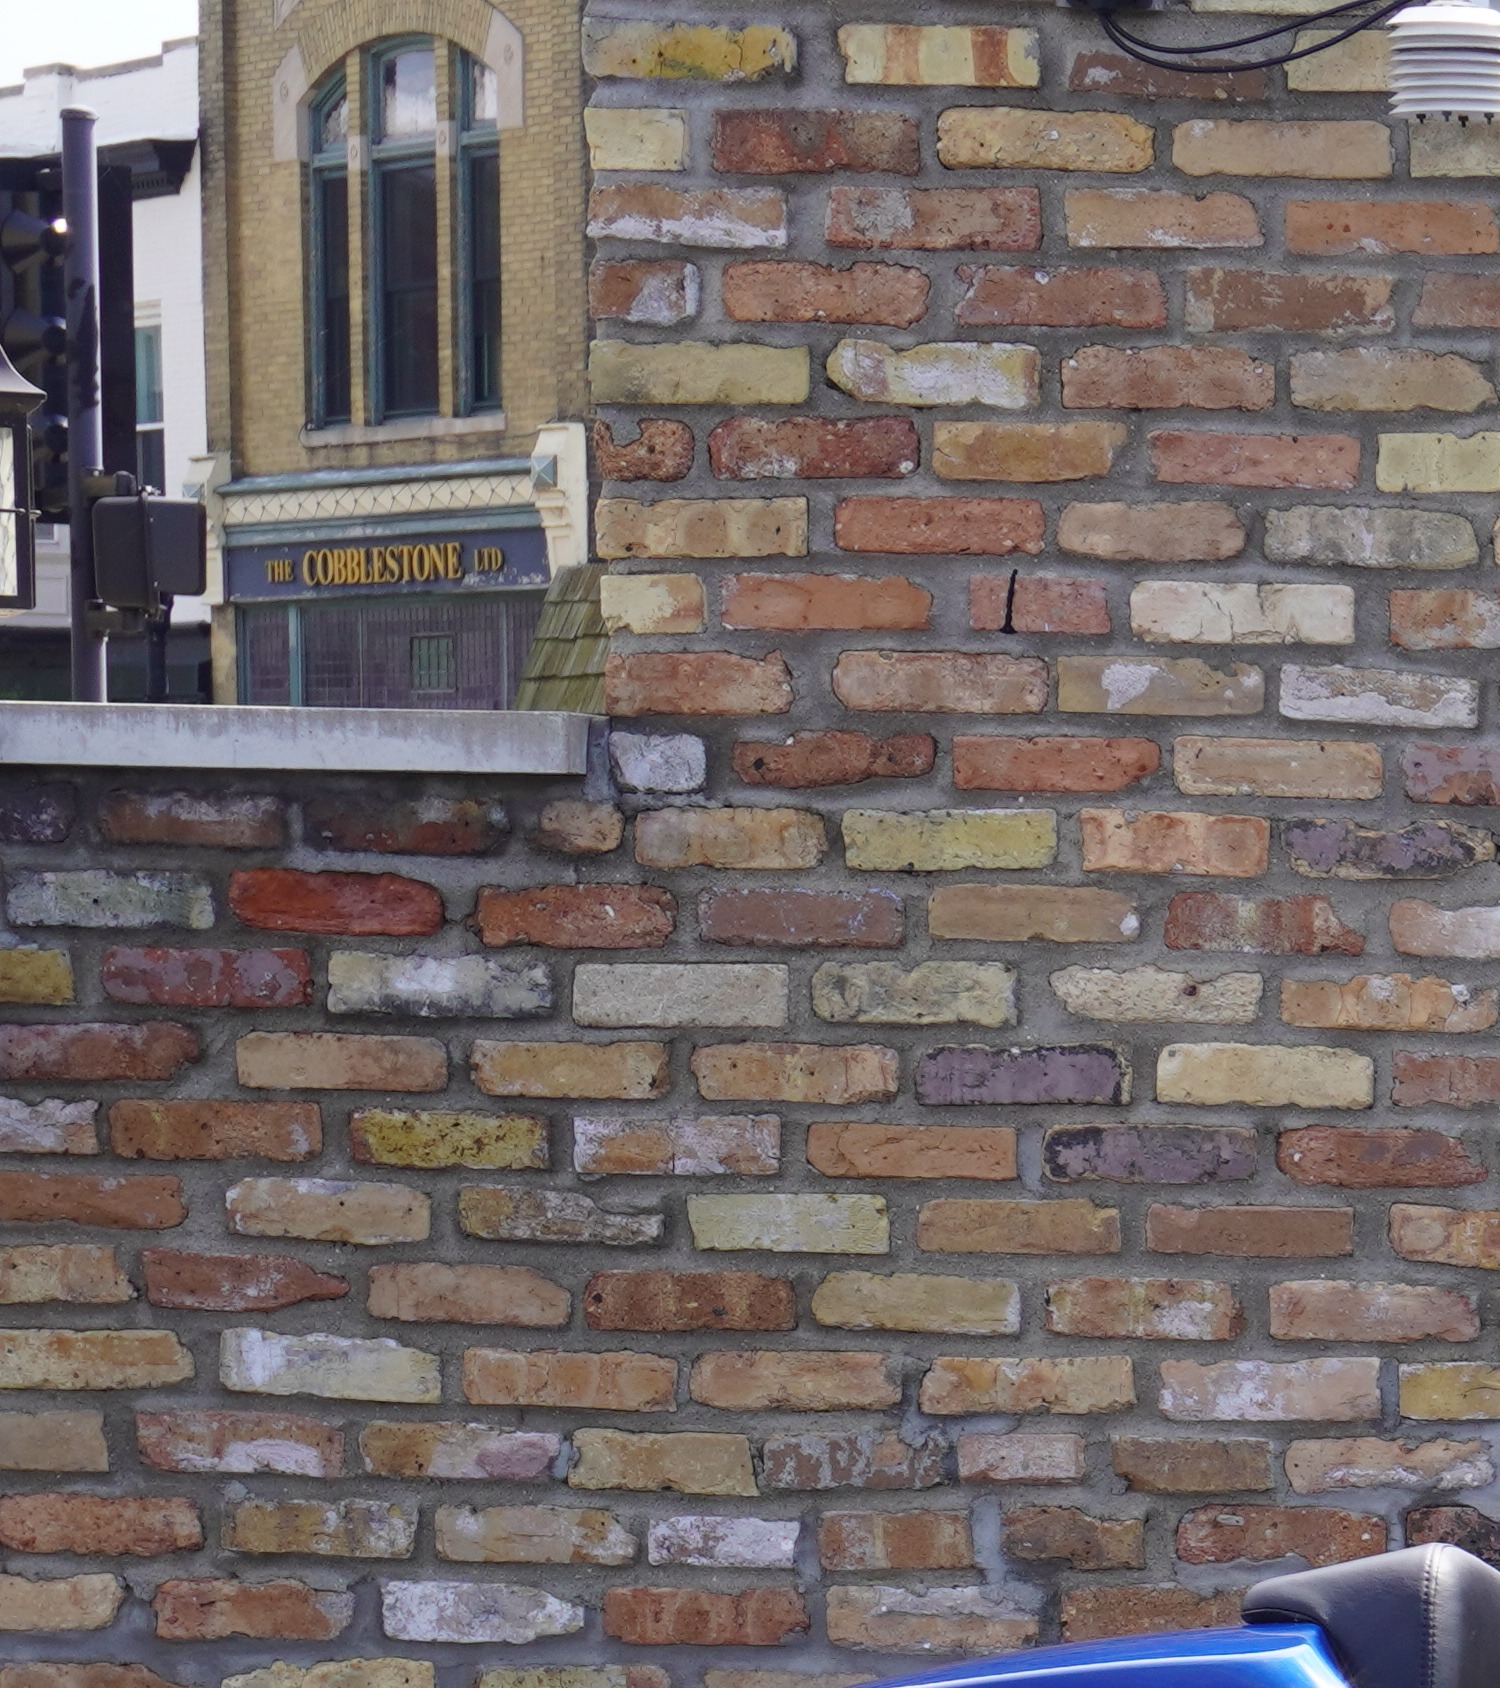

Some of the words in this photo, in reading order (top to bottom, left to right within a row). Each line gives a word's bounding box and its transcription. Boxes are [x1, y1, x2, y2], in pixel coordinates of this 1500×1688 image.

[265, 559, 295, 584] THE
[302, 541, 462, 586] COBBLESTONE
[474, 547, 504, 572] LTD
